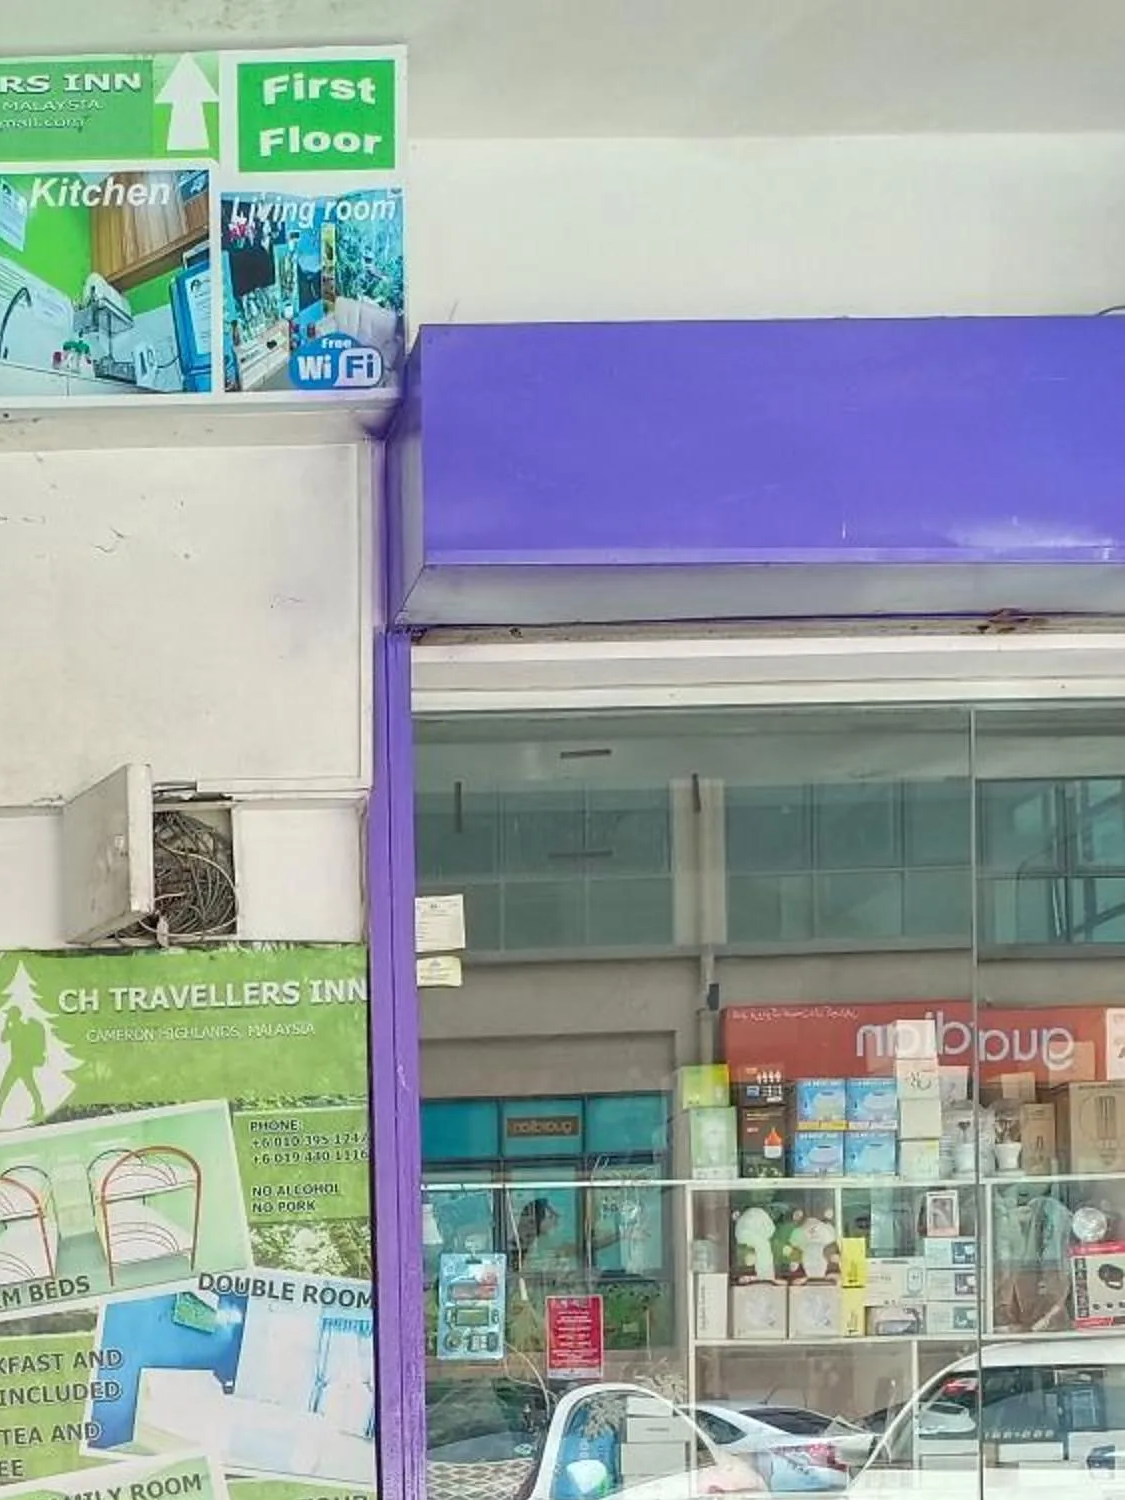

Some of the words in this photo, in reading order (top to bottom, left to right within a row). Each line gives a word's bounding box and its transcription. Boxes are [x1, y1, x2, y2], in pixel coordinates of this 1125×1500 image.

[63, 72, 143, 94] INN
[262, 72, 378, 105] First
[259, 126, 383, 158] Floor
[30, 177, 170, 208] Kitchen
[229, 198, 317, 228] Living
[323, 199, 397, 225] room
[58, 987, 100, 1014] CH
[109, 980, 301, 1012] TRAVELLERS
[309, 977, 367, 1005] INN
[86, 1027, 155, 1044] CAMERON
[247, 1022, 316, 1039] MALAYSIA
[252, 1185, 273, 1197] NO
[277, 1183, 339, 1197] ALCOHOL
[252, 1201, 274, 1213] NO
[278, 1200, 316, 1212] PORK
[29, 1275, 91, 1302] BEDS
[197, 1272, 294, 1302] DOUBLE
[302, 1285, 374, 1310] ROOM
[73, 1348, 124, 1370] AND
[0, 1426, 43, 1446] TEA
[50, 1422, 103, 1442] AND
